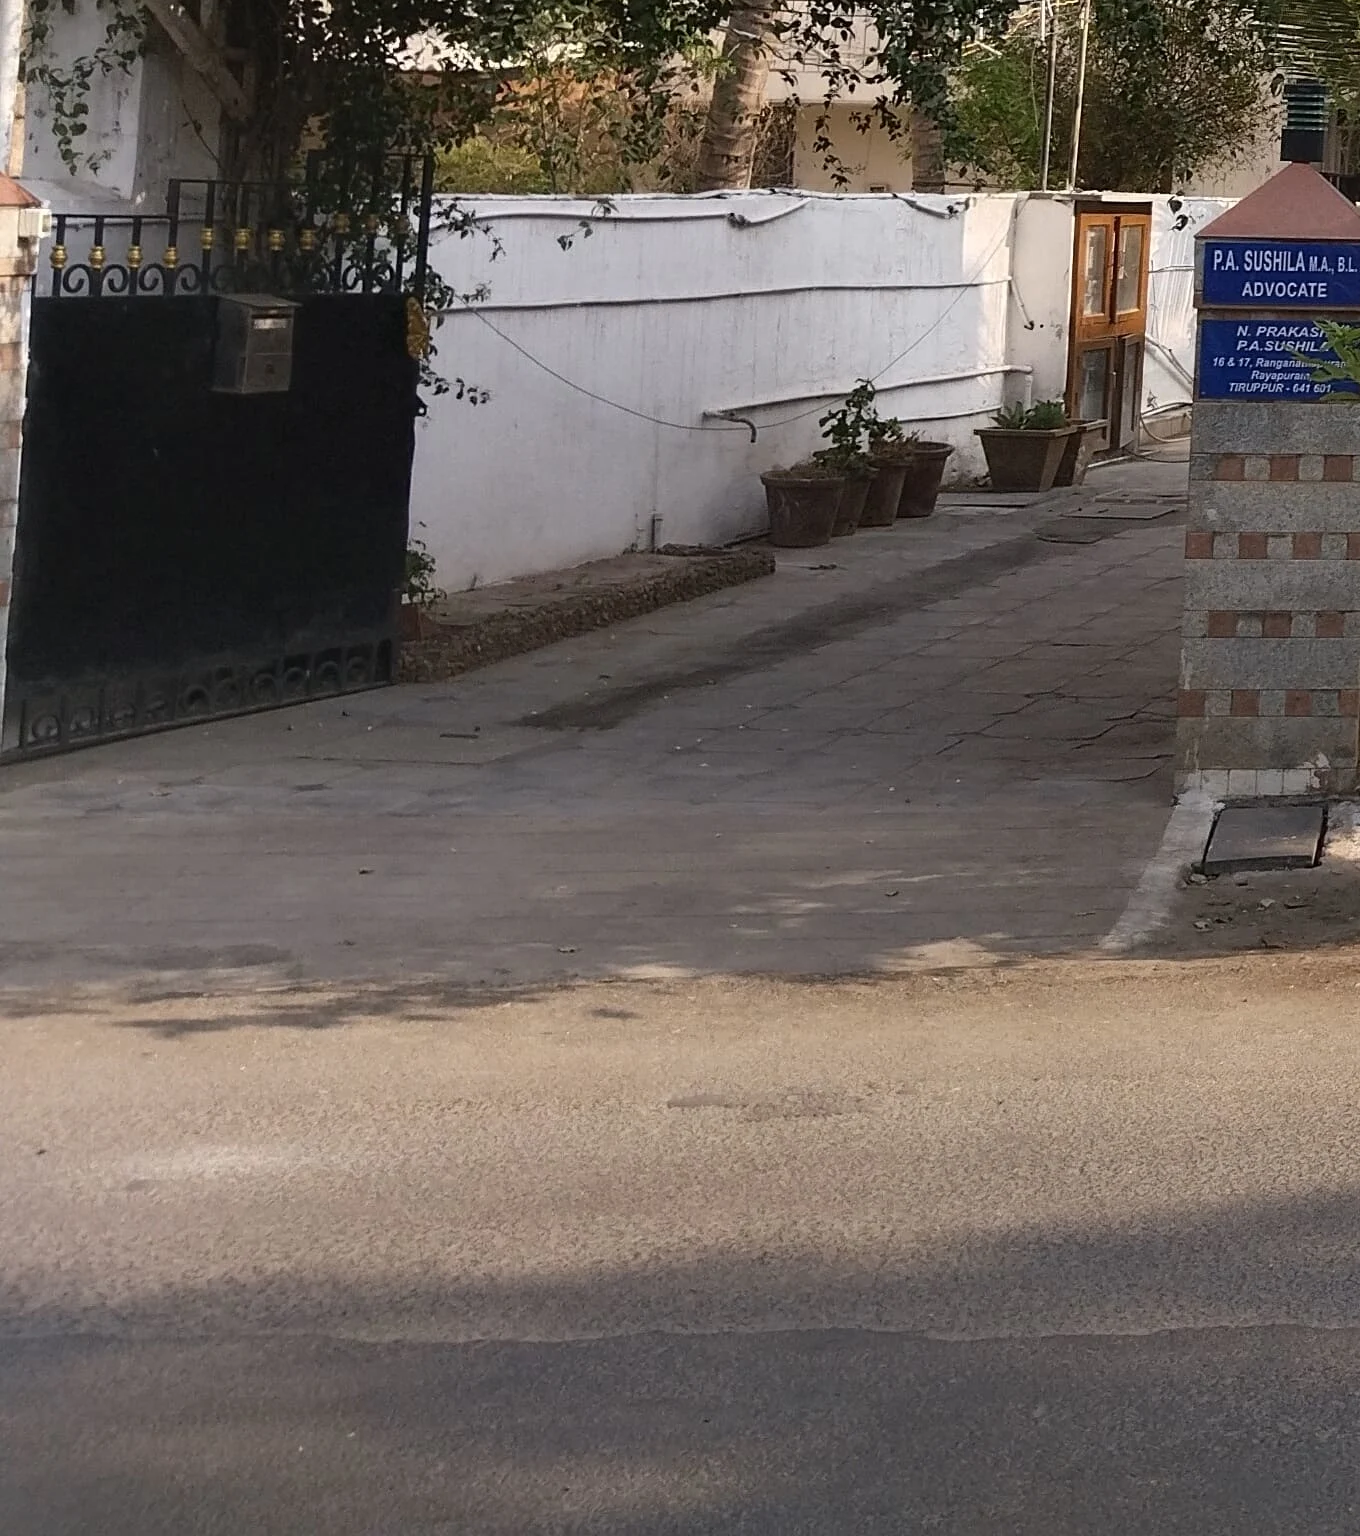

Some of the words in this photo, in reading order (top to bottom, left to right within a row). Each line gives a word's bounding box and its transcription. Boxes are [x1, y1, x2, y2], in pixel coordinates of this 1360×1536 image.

[1213, 249, 1240, 271] P.A.
[1244, 250, 1306, 272] SUSHILA
[1337, 256, 1358, 273] B.L.
[1242, 281, 1328, 298] ADVOCATE
[1237, 325, 1251, 337] N.
[1213, 357, 1225, 367] 16
[1227, 357, 1235, 367] &
[1229, 382, 1284, 393] TIRUPPUR
[1292, 383, 1310, 393] 641
